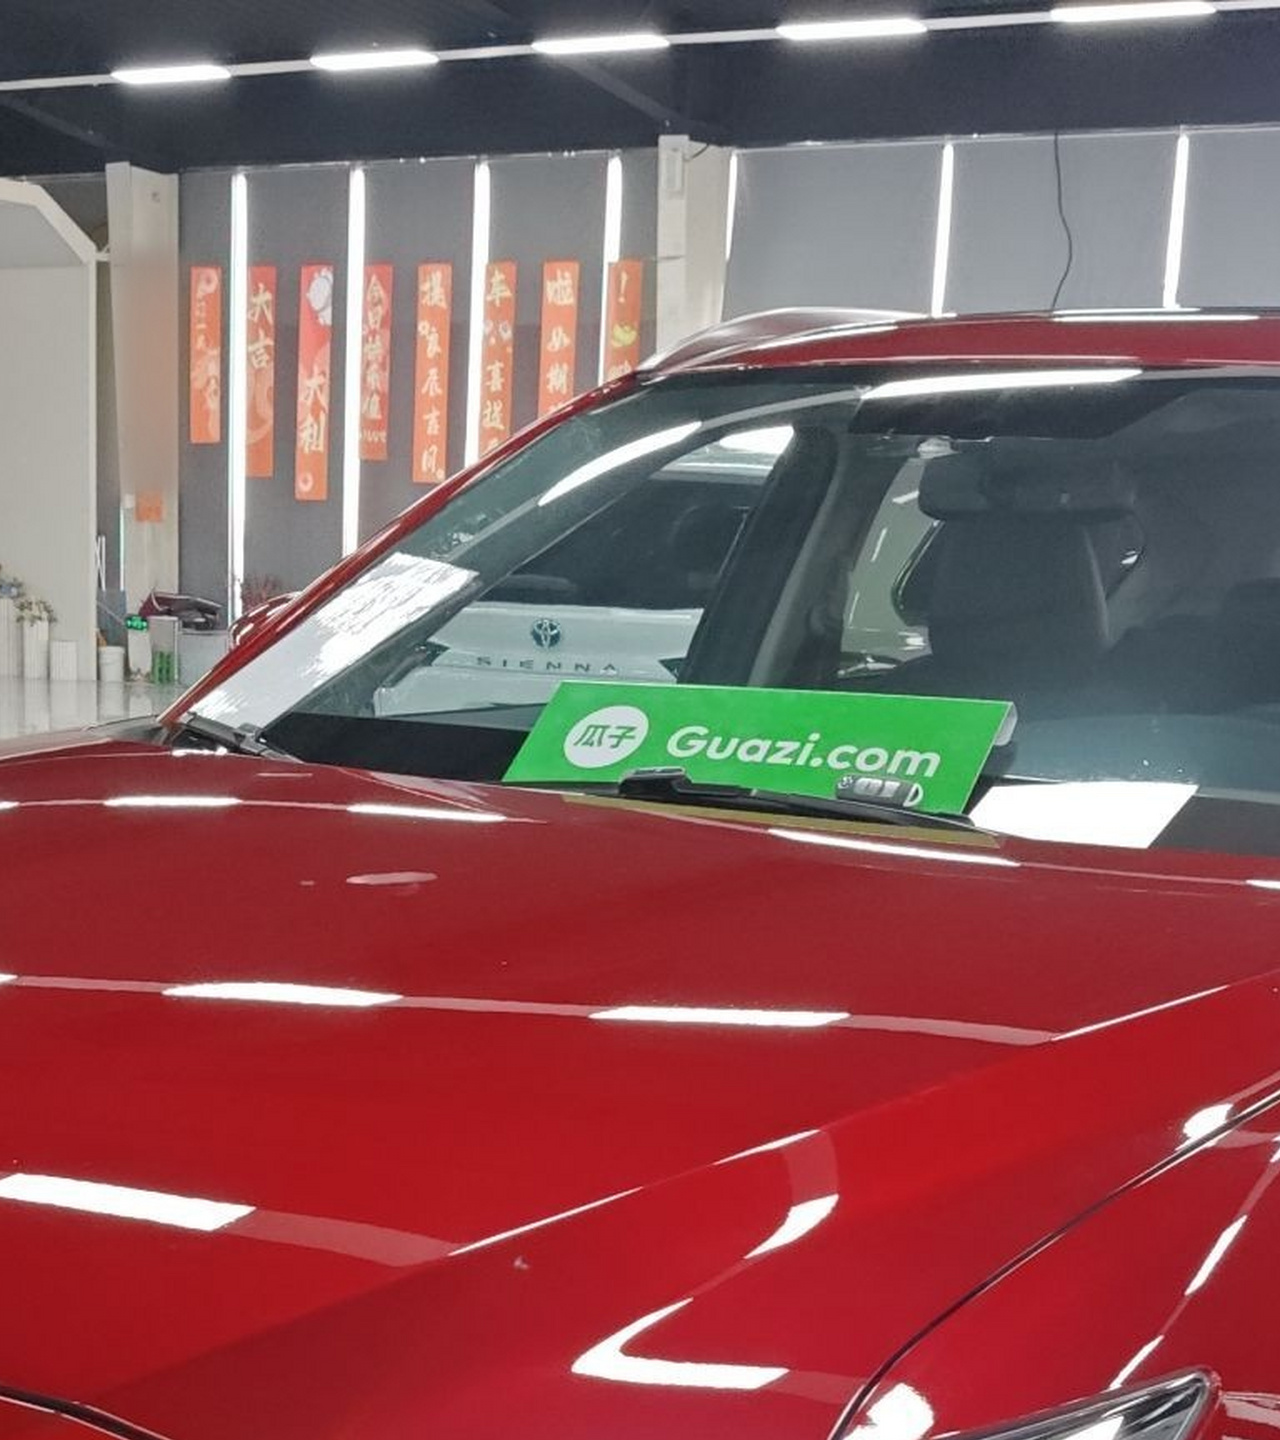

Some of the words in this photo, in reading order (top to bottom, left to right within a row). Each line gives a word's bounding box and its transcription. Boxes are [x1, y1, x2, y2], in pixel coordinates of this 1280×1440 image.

[476, 656, 617, 673] SIENNA
[572, 723, 637, 748] 瓜子
[666, 725, 941, 778] Guazi.com
